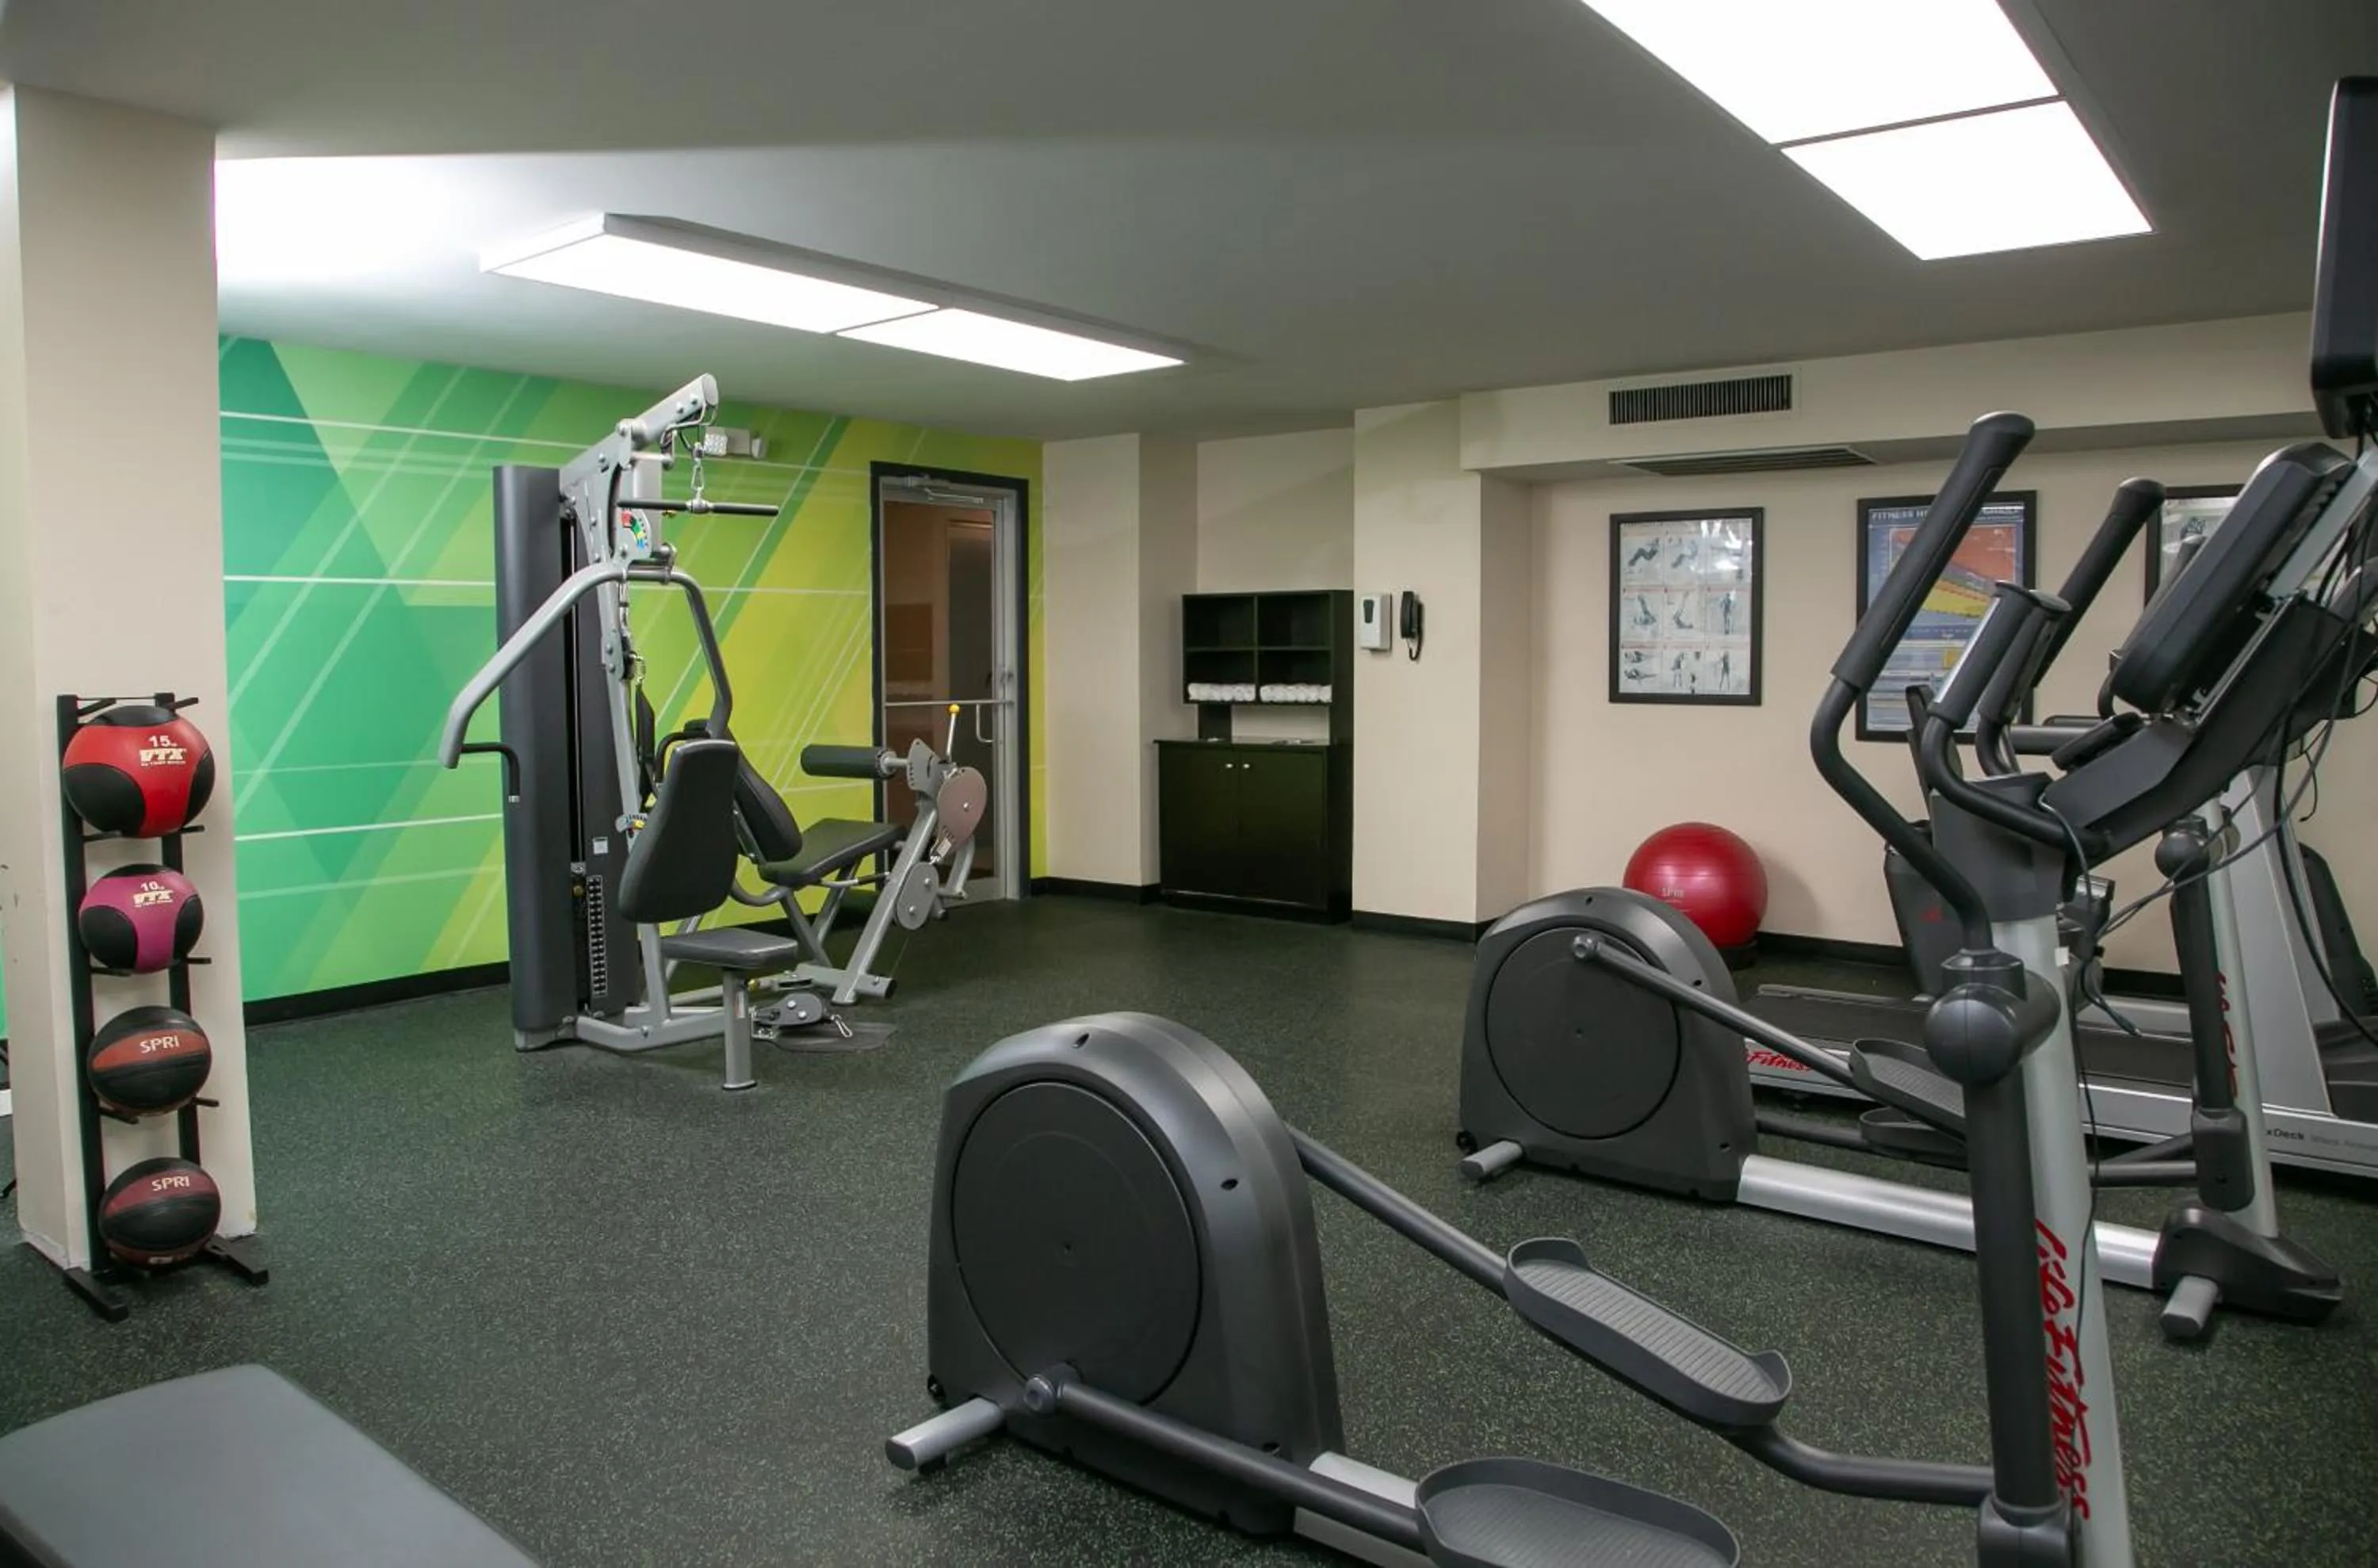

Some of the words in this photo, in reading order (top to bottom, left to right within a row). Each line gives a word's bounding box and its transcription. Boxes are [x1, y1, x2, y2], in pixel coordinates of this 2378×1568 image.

[148, 734, 171, 748] 15
[140, 881, 159, 892] 10
[139, 1034, 180, 1054] SPRI
[151, 1176, 190, 1191] SPRI
